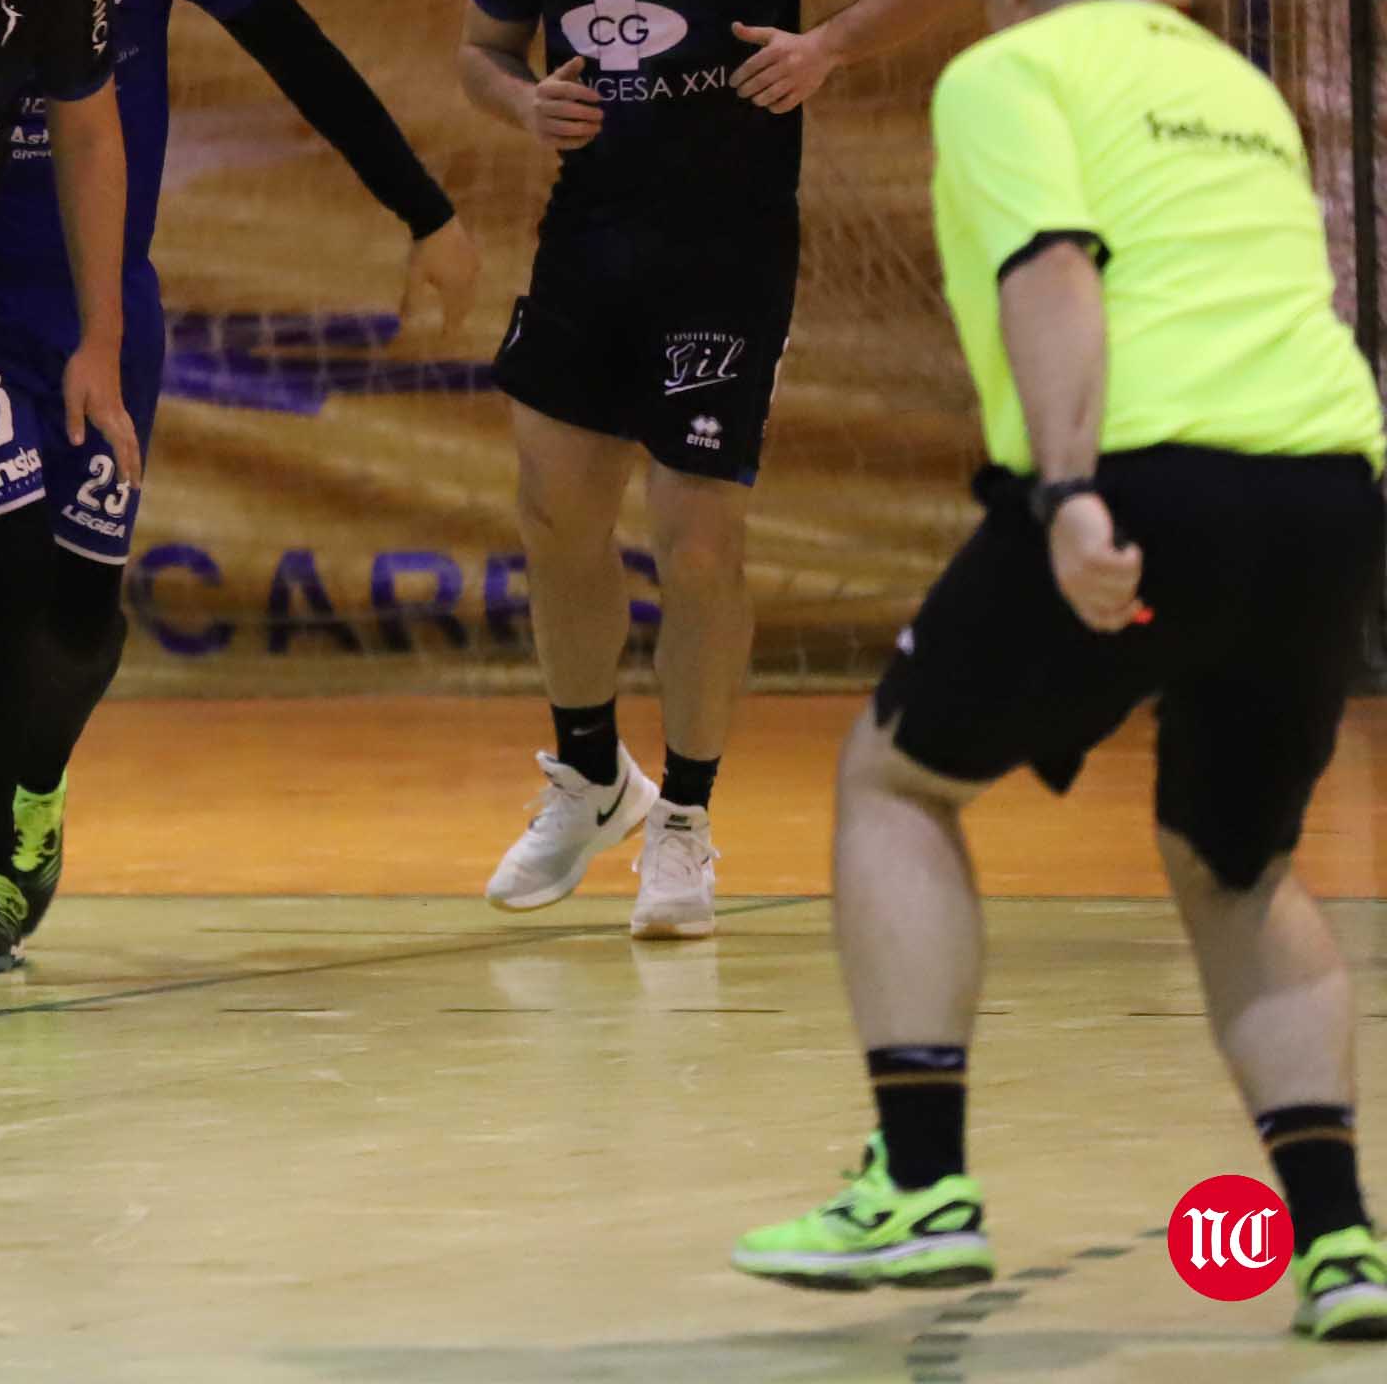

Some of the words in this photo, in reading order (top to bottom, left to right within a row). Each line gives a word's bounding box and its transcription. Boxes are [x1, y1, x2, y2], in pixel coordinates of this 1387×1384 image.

[588, 15, 650, 47] CG
[682, 65, 726, 96] XXI
[686, 432, 722, 450] errea
[76, 454, 131, 519] 23
[61, 504, 126, 538] LEGEA
